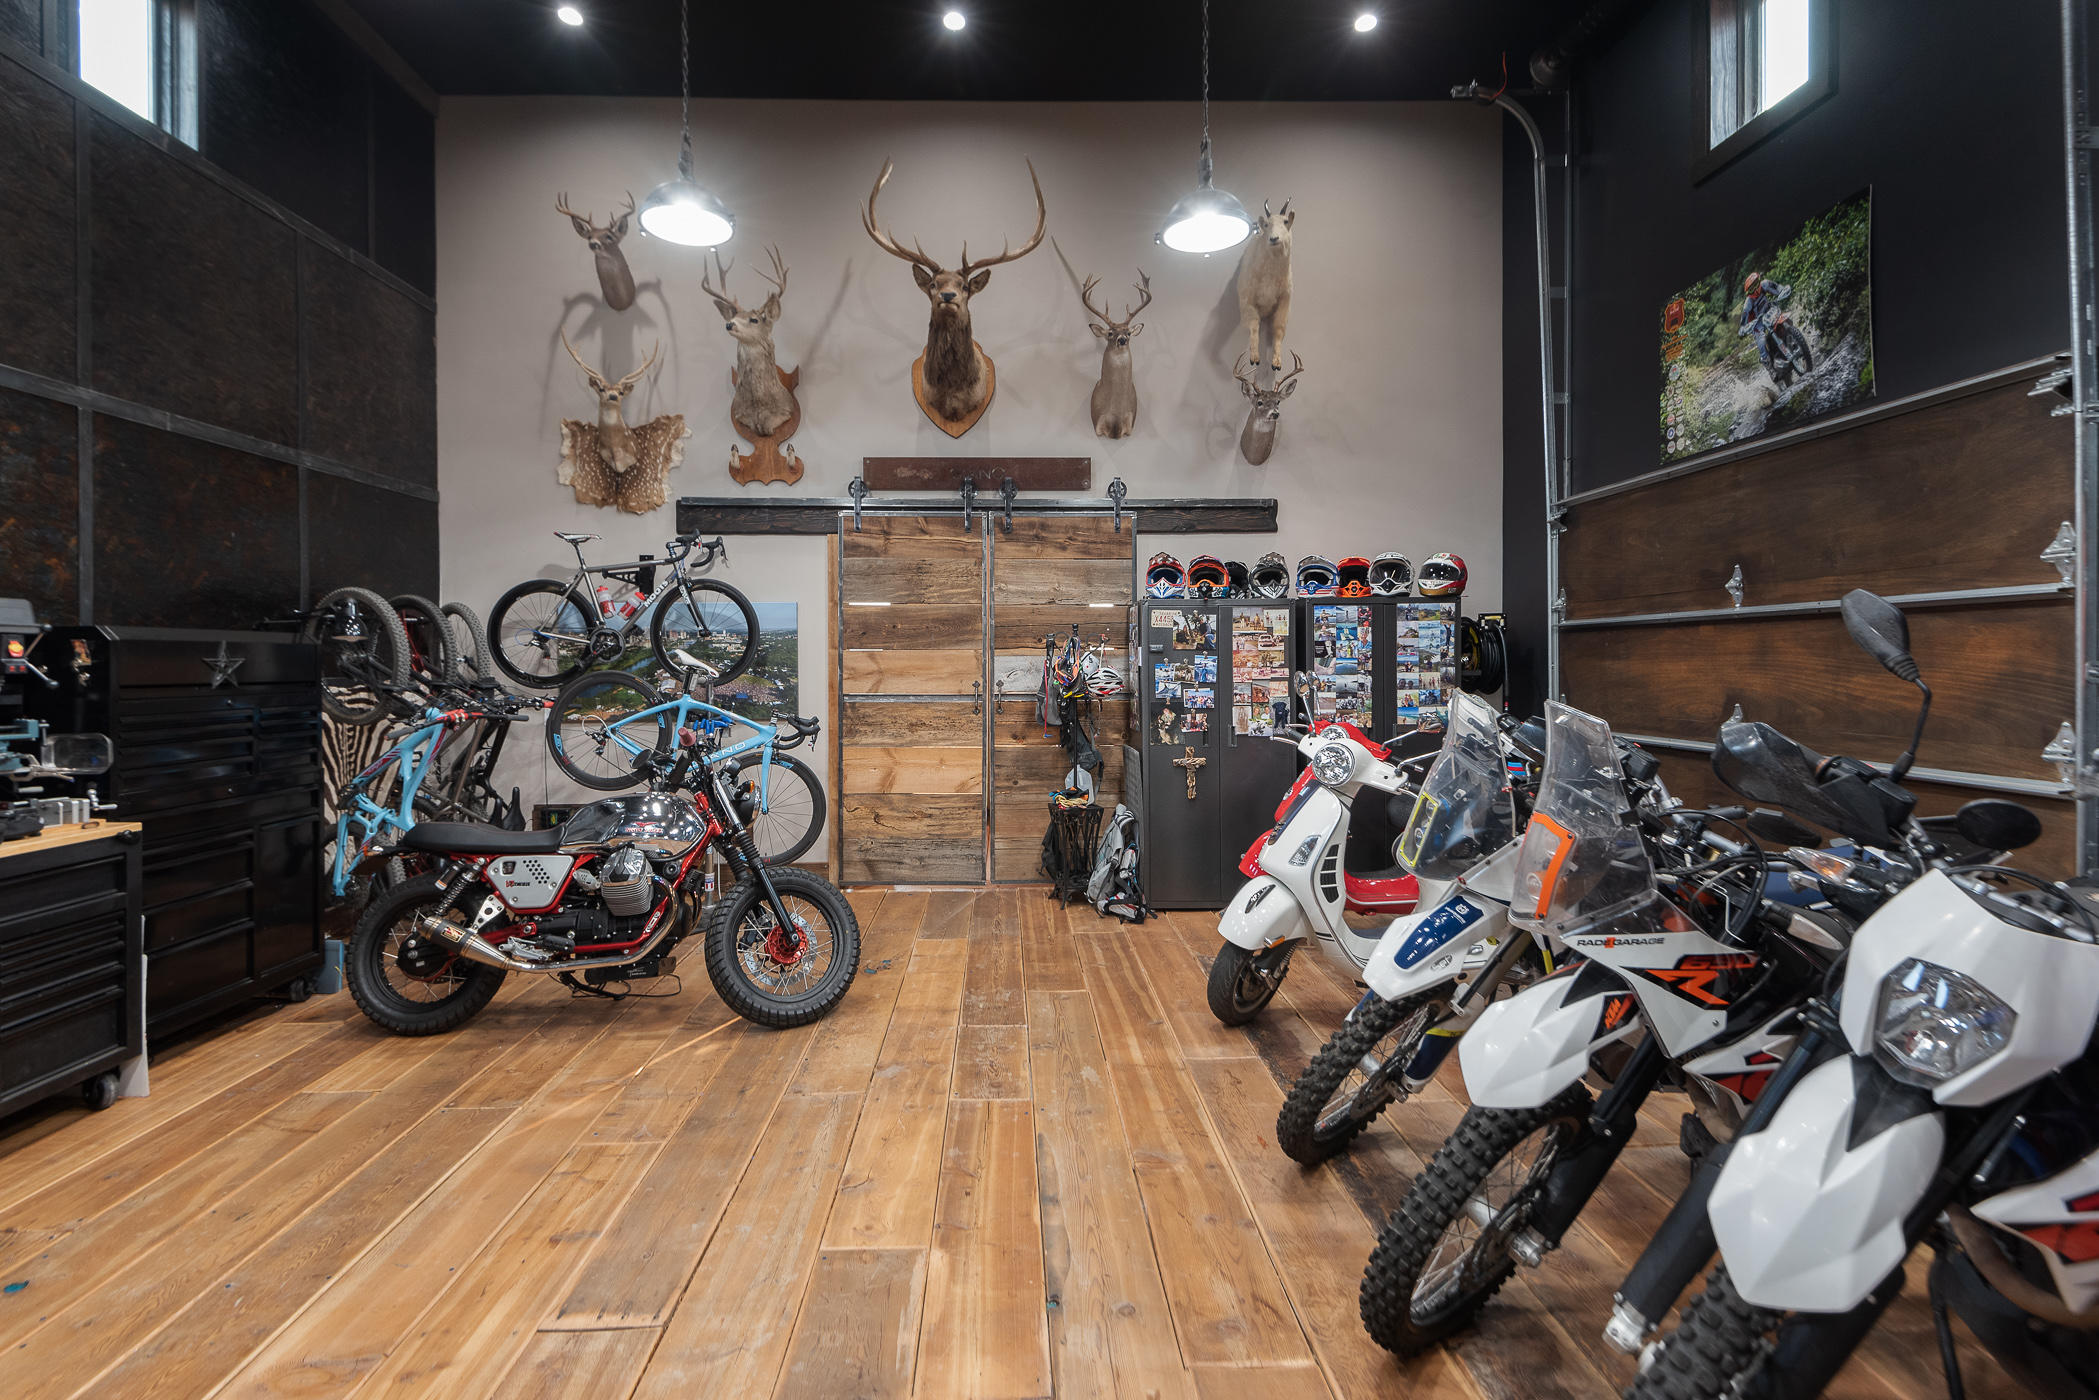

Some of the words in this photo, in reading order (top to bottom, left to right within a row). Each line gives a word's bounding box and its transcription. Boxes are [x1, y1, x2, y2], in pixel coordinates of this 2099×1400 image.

[643, 580, 669, 607] MOOTS
[1613, 937, 1665, 946] GARAGE
[1604, 997, 1622, 1029] KTM
